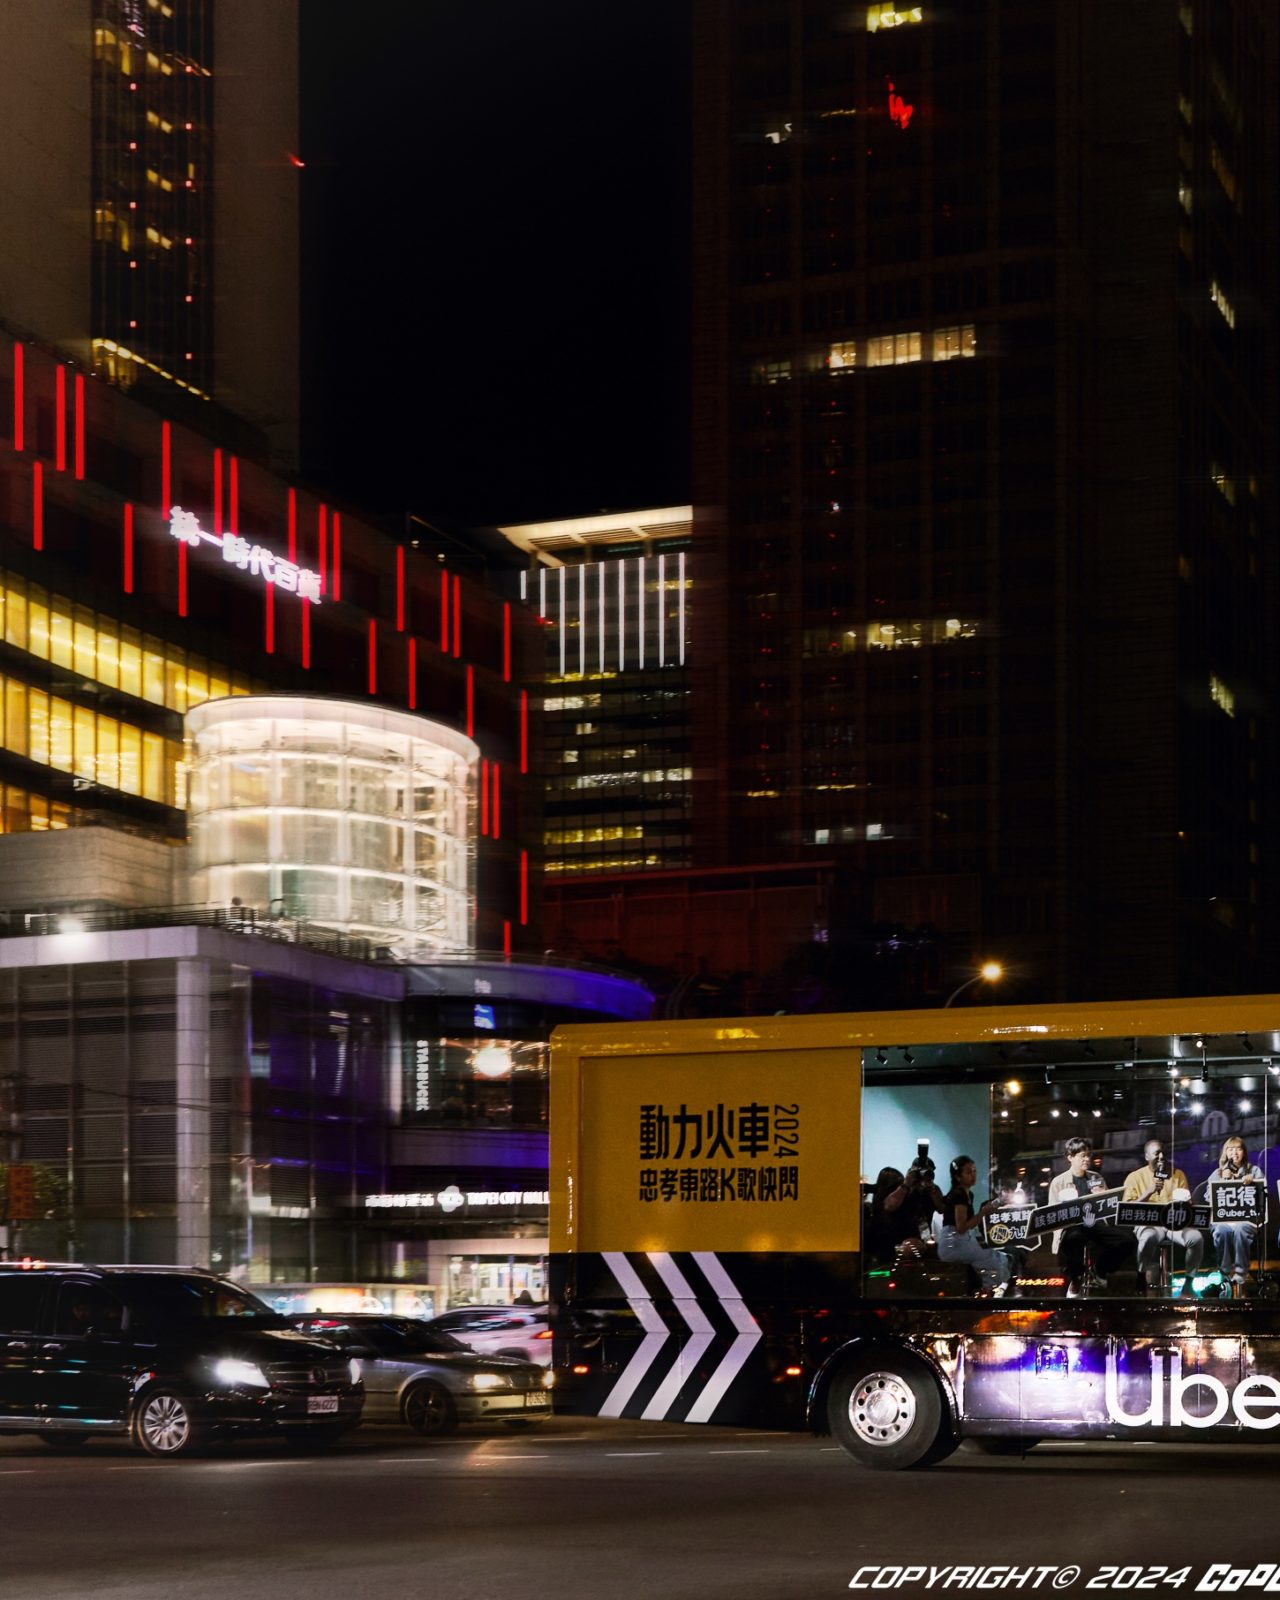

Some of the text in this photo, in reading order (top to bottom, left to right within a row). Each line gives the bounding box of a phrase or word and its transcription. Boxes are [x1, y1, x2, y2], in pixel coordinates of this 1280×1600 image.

[640, 1102, 769, 1160] 動力火車
[773, 1103, 799, 1159] 2024
[500, 1192, 523, 1205] CITY
[639, 1166, 799, 1203] 忠孝東路K歌快閃
[1216, 1186, 1256, 1207] 記得
[1096, 1196, 1118, 1212] 了吧
